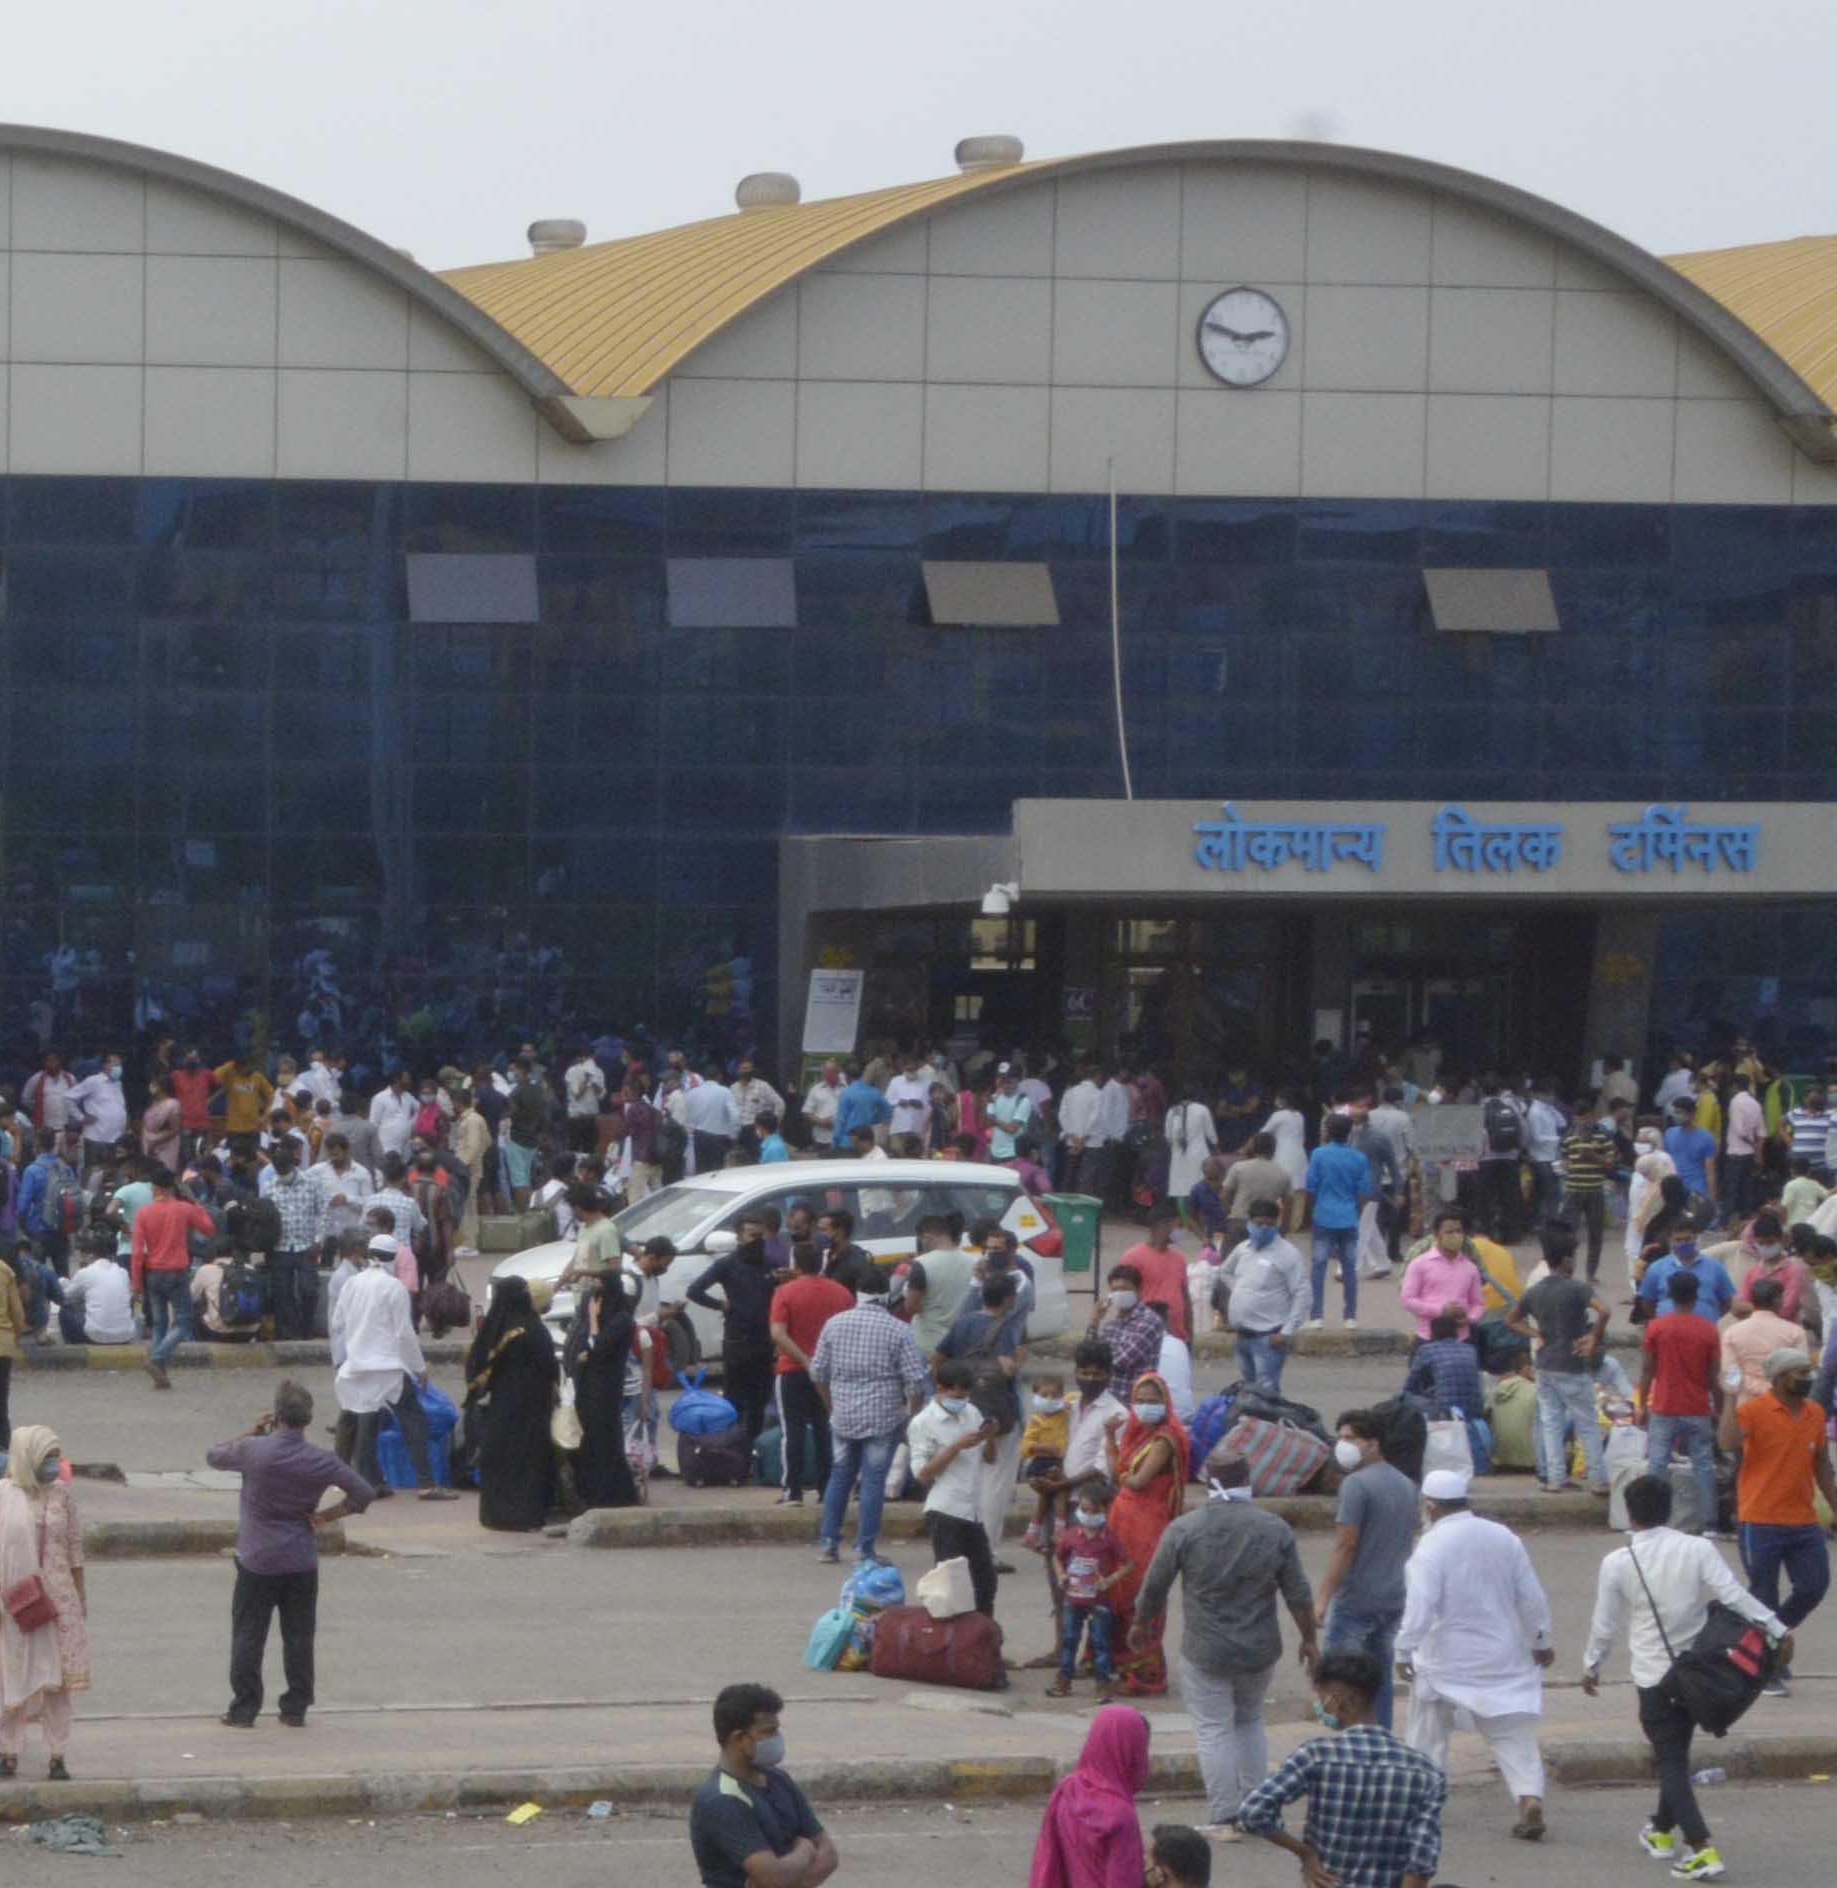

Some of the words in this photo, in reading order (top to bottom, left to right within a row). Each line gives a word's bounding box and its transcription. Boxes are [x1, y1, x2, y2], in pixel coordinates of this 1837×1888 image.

[1195, 803, 1387, 871] लोकमान्य
[1433, 804, 1564, 871] तिलक
[1610, 804, 1761, 871] टर्मिनस
